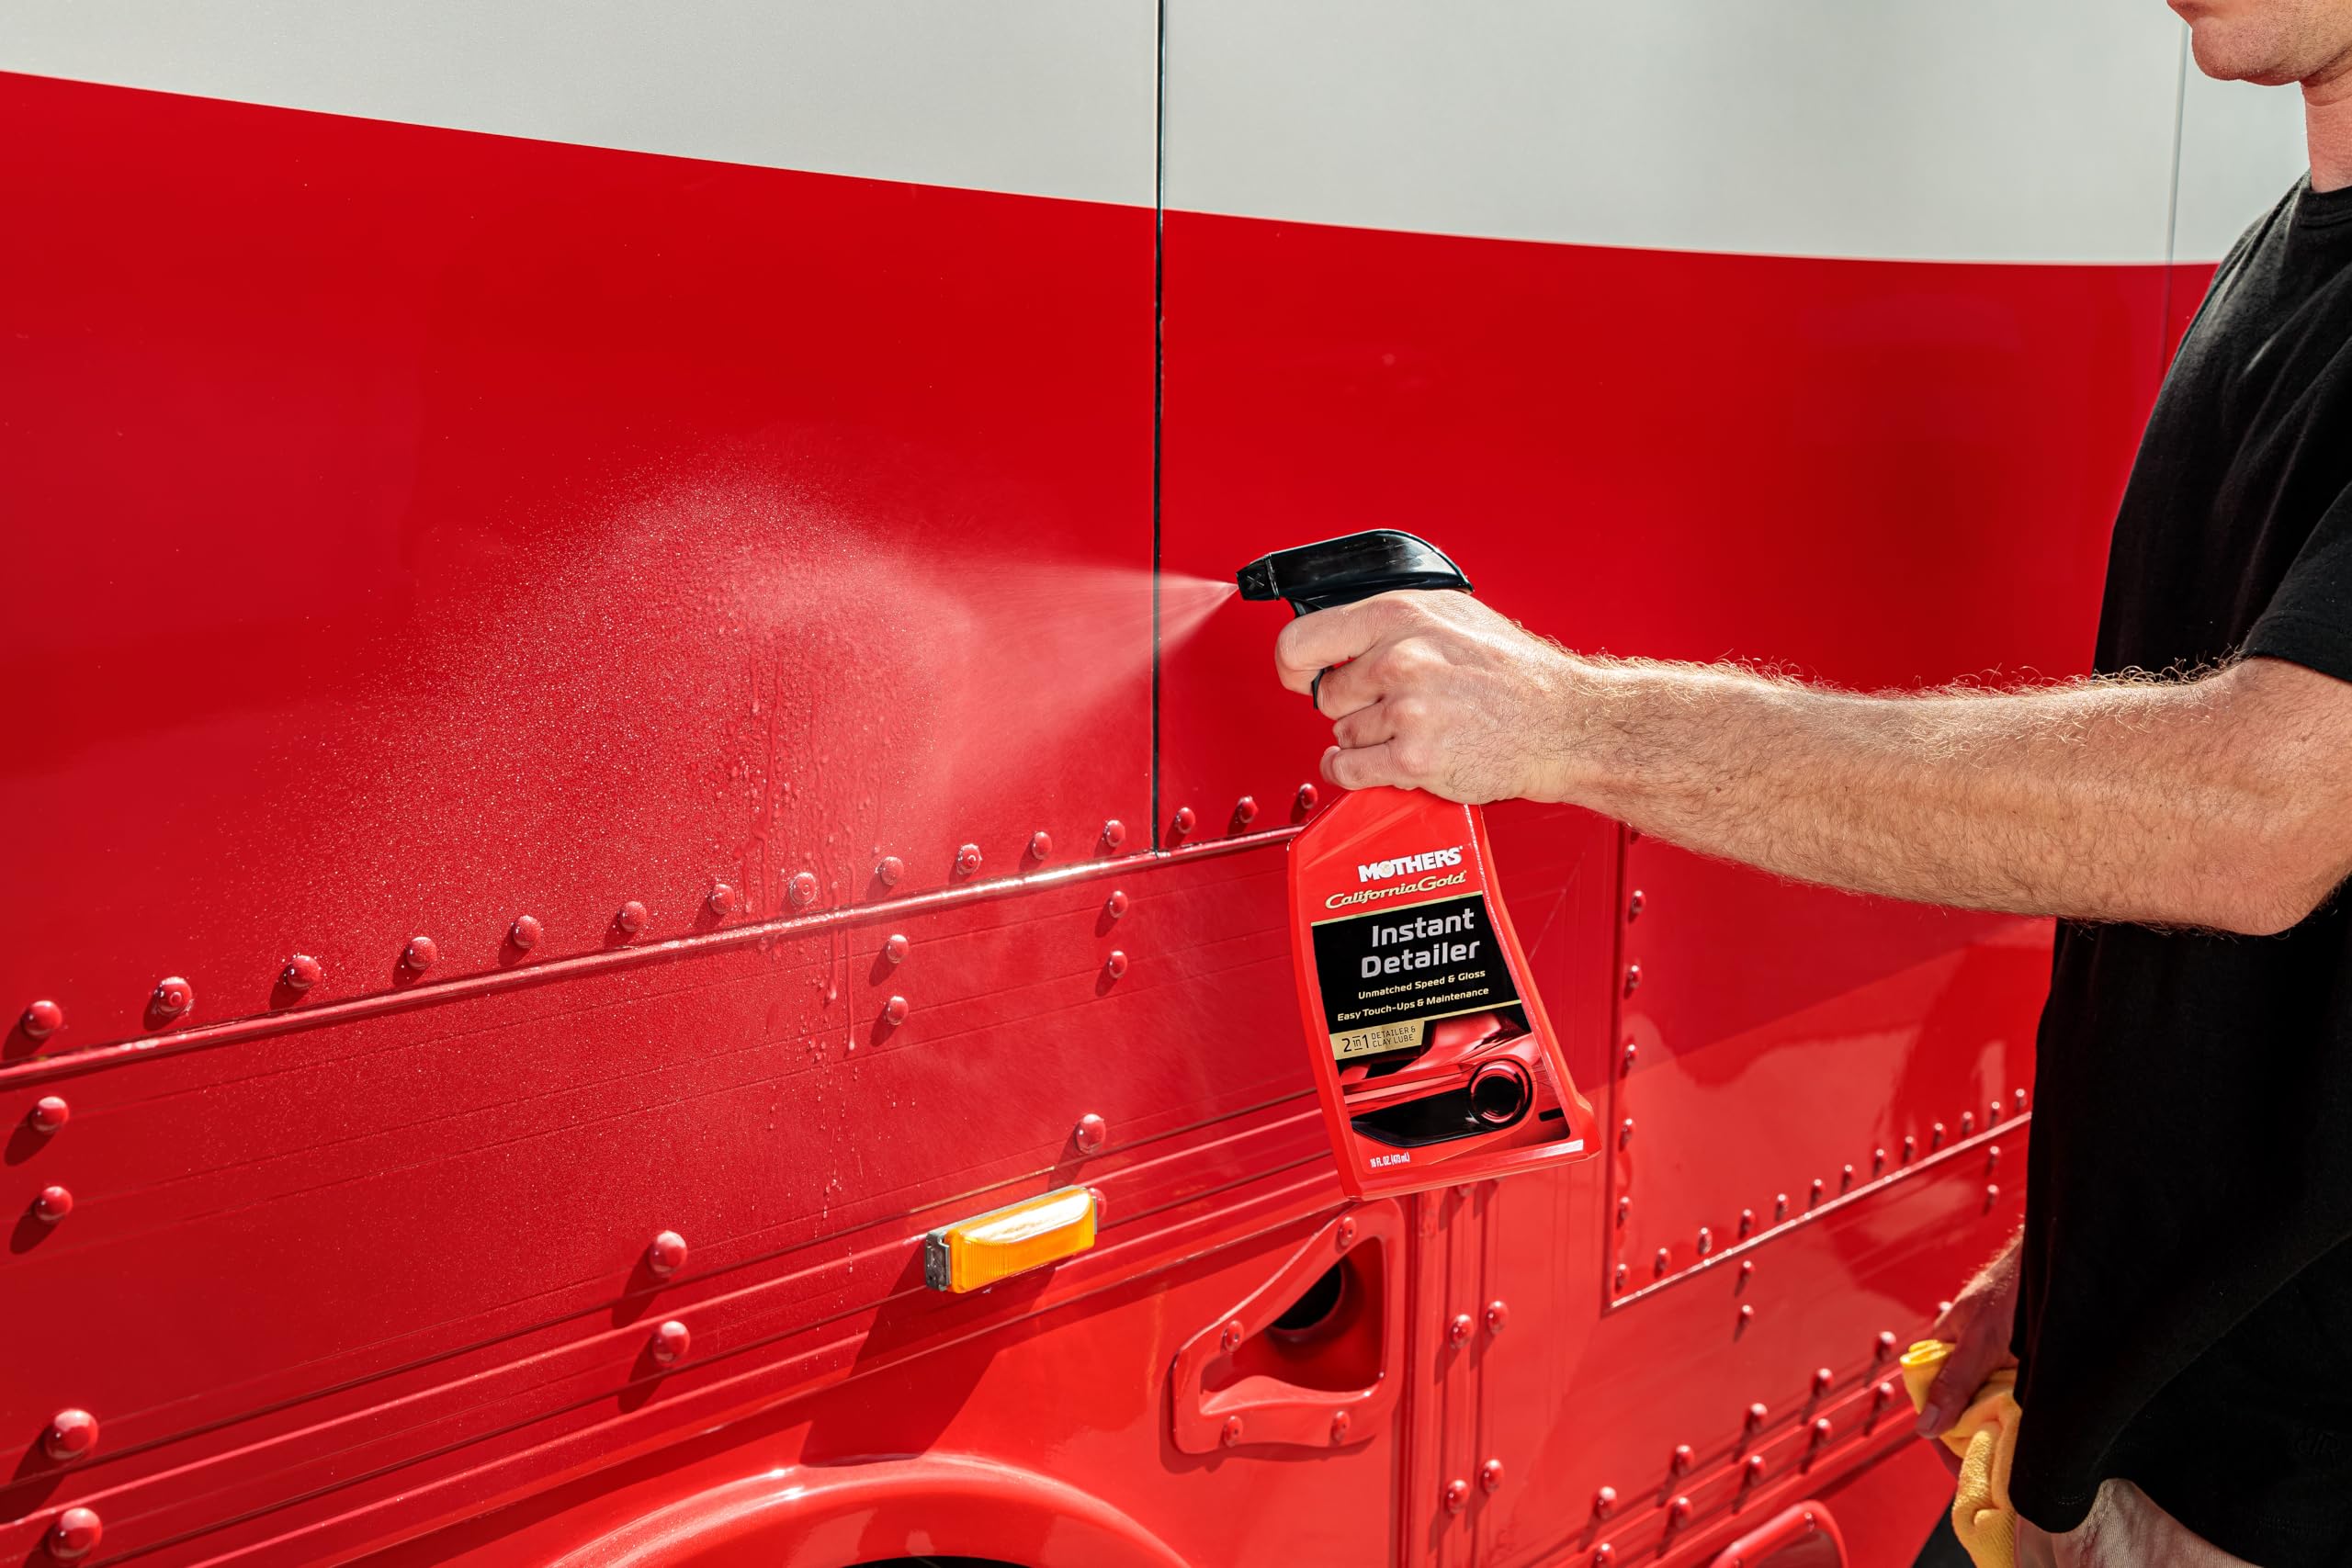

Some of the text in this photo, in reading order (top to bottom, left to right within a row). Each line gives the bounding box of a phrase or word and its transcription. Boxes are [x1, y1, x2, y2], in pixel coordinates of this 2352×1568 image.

[1358, 846, 1463, 882] MOTHERS
[1372, 908, 1475, 948] Instant
[1361, 941, 1481, 979] Detailer
[1358, 970, 1486, 999] Unmatched Speed & Gloss
[1337, 987, 1489, 1021] Easy Touch-Ups & Maintenance
[1371, 1026, 1409, 1040] DETAILER
[1372, 1033, 1414, 1048] CLAY LUBE
